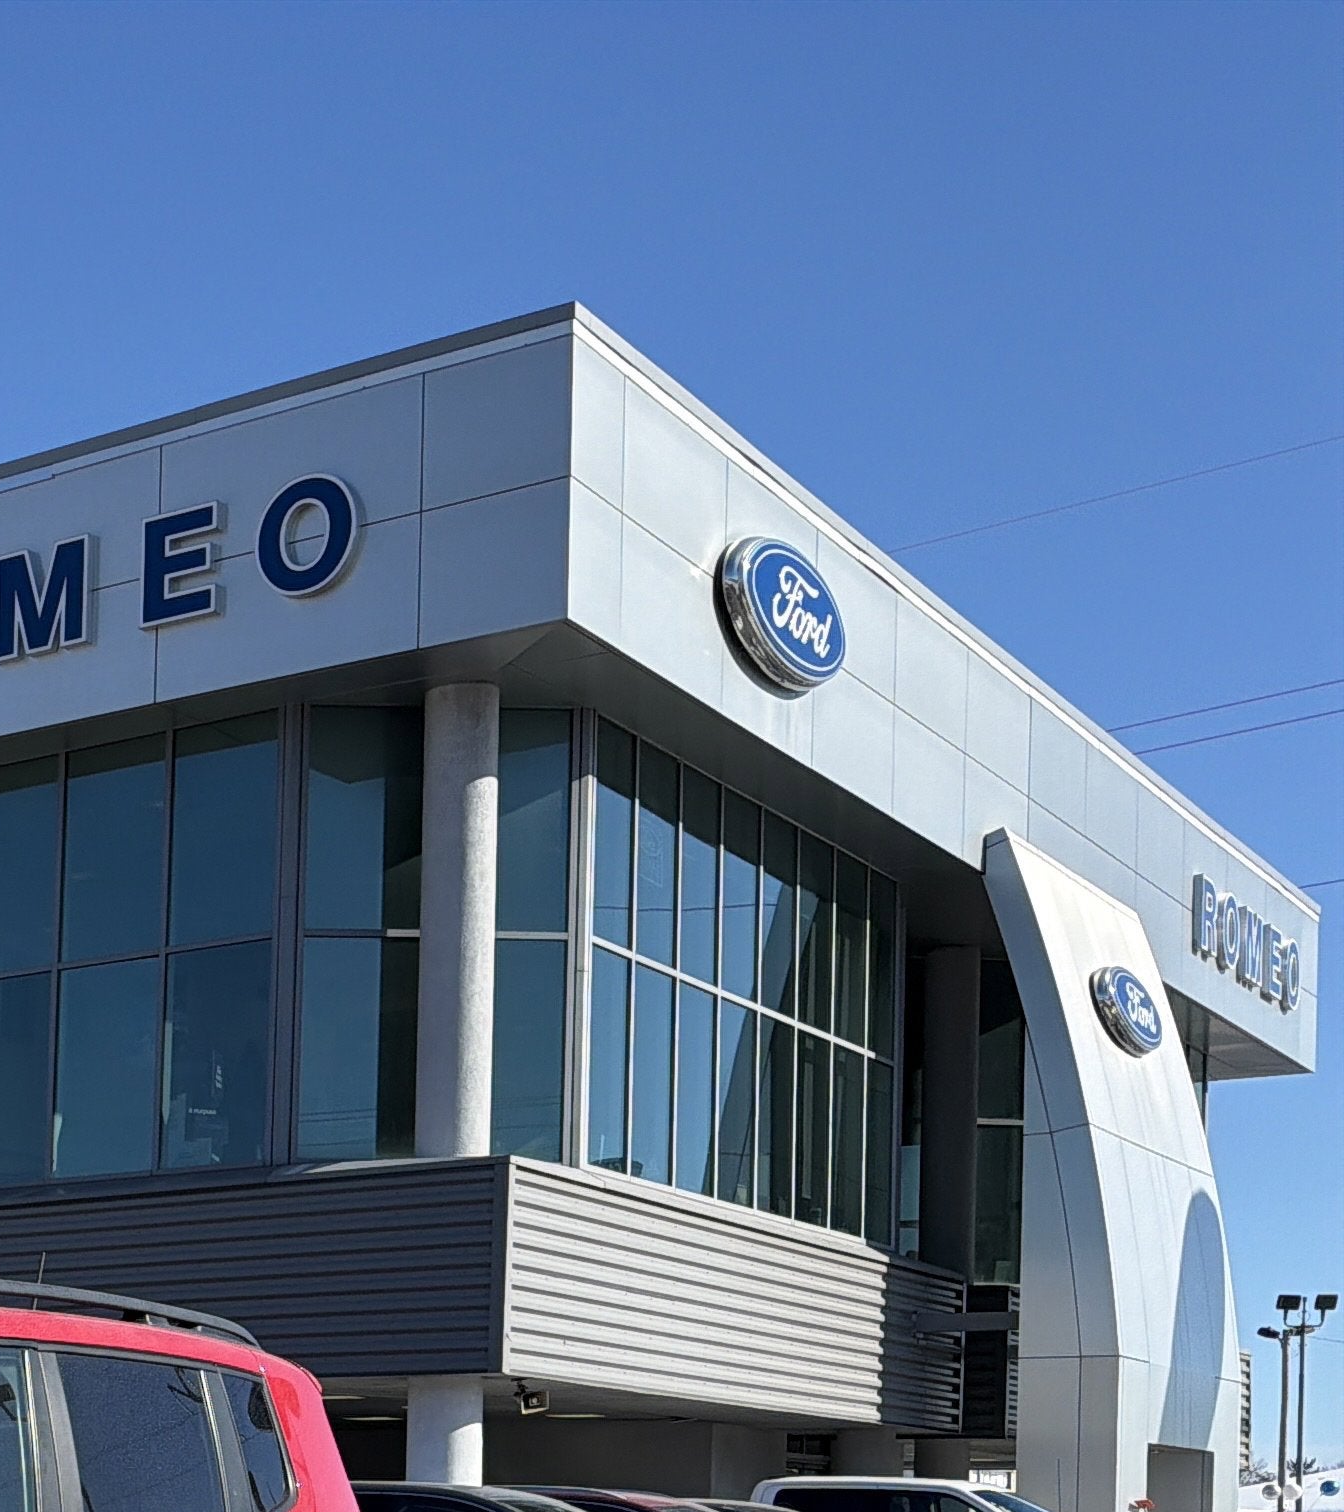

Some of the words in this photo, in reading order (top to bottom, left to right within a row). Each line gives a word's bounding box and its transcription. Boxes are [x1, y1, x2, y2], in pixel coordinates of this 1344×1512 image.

[772, 565, 833, 658] Ford
[1192, 873, 1300, 1012] ROMEO
[1125, 981, 1157, 1034] Ford
